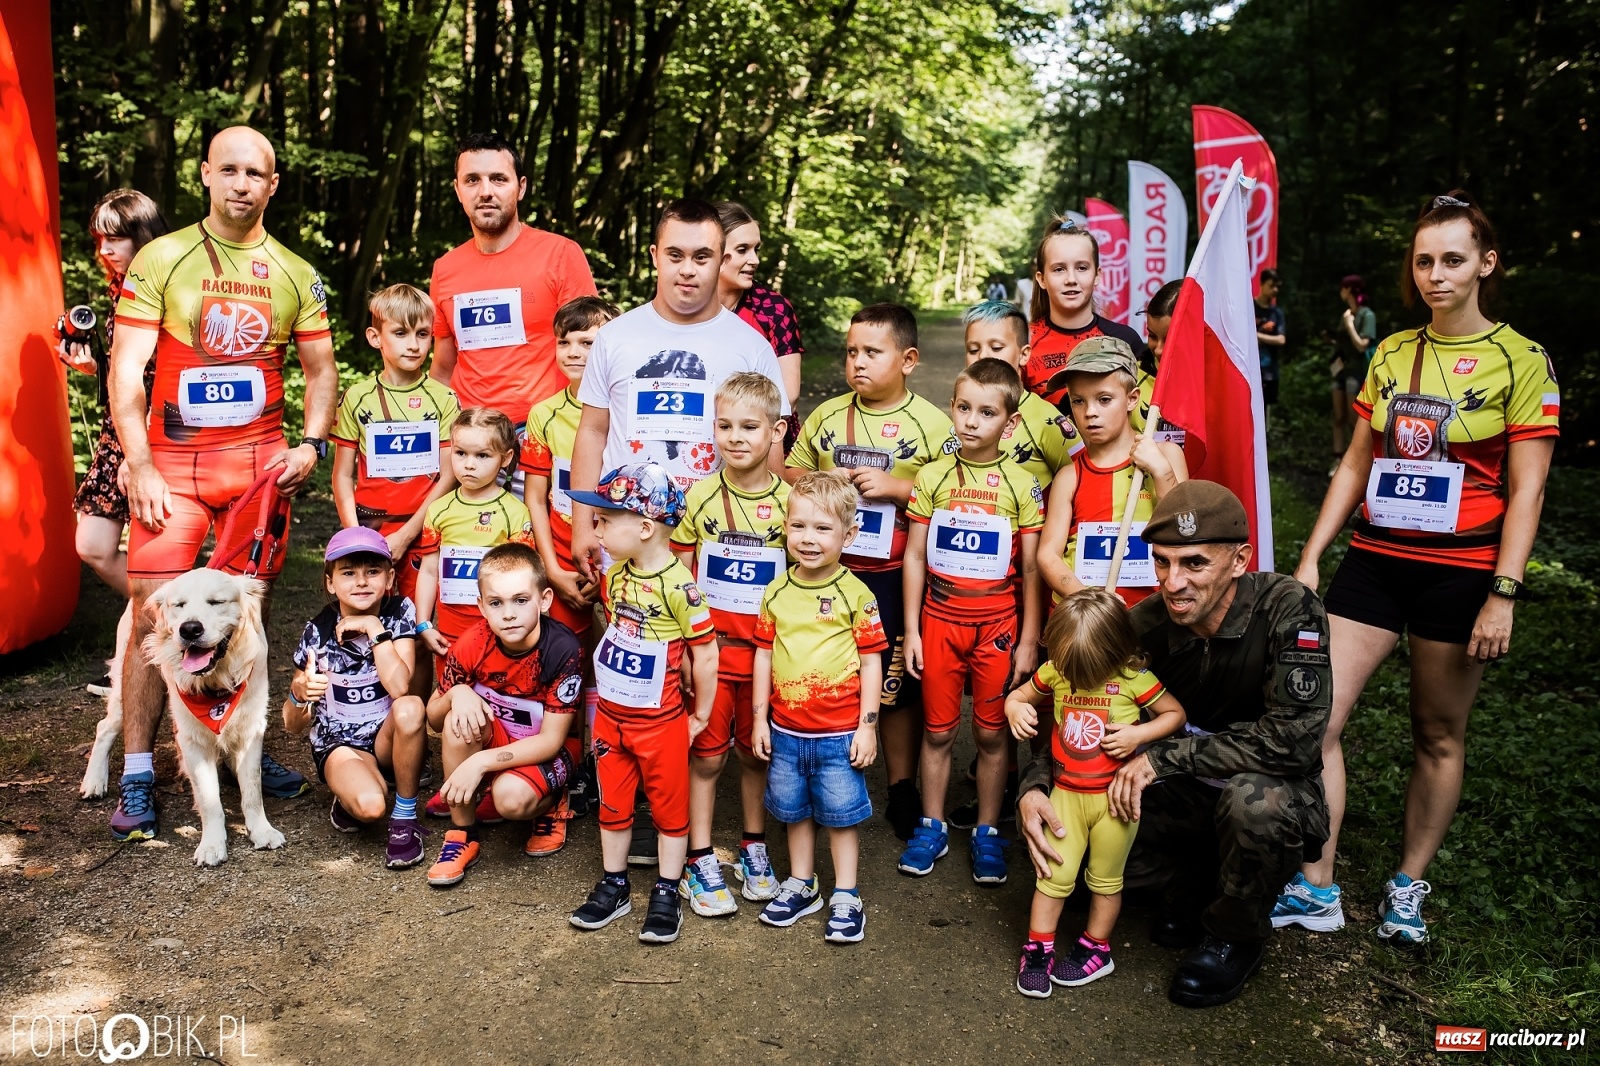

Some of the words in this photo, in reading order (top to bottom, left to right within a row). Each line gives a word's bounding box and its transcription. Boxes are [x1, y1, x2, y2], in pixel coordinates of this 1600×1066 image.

[202, 279, 272, 299] RACIBORKI
[471, 306, 495, 325] 76
[1044, 358, 1066, 369] RACE
[205, 383, 234, 401] 80
[654, 393, 685, 412] 23
[1394, 400, 1448, 417] RACIBORKI
[390, 435, 416, 452] 47
[840, 453, 887, 467] RACIBORKI
[949, 488, 998, 502] RACIBORKI
[1395, 476, 1427, 497] 85
[855, 511, 864, 528] 4
[723, 536, 762, 547] RACIBORKI
[951, 531, 980, 550] 40
[452, 560, 477, 577] 77
[724, 561, 756, 581] 45
[607, 645, 642, 675] 113
[347, 686, 376, 703] 96
[1062, 694, 1112, 707] RACIBORKI
[490, 703, 515, 721] 82
